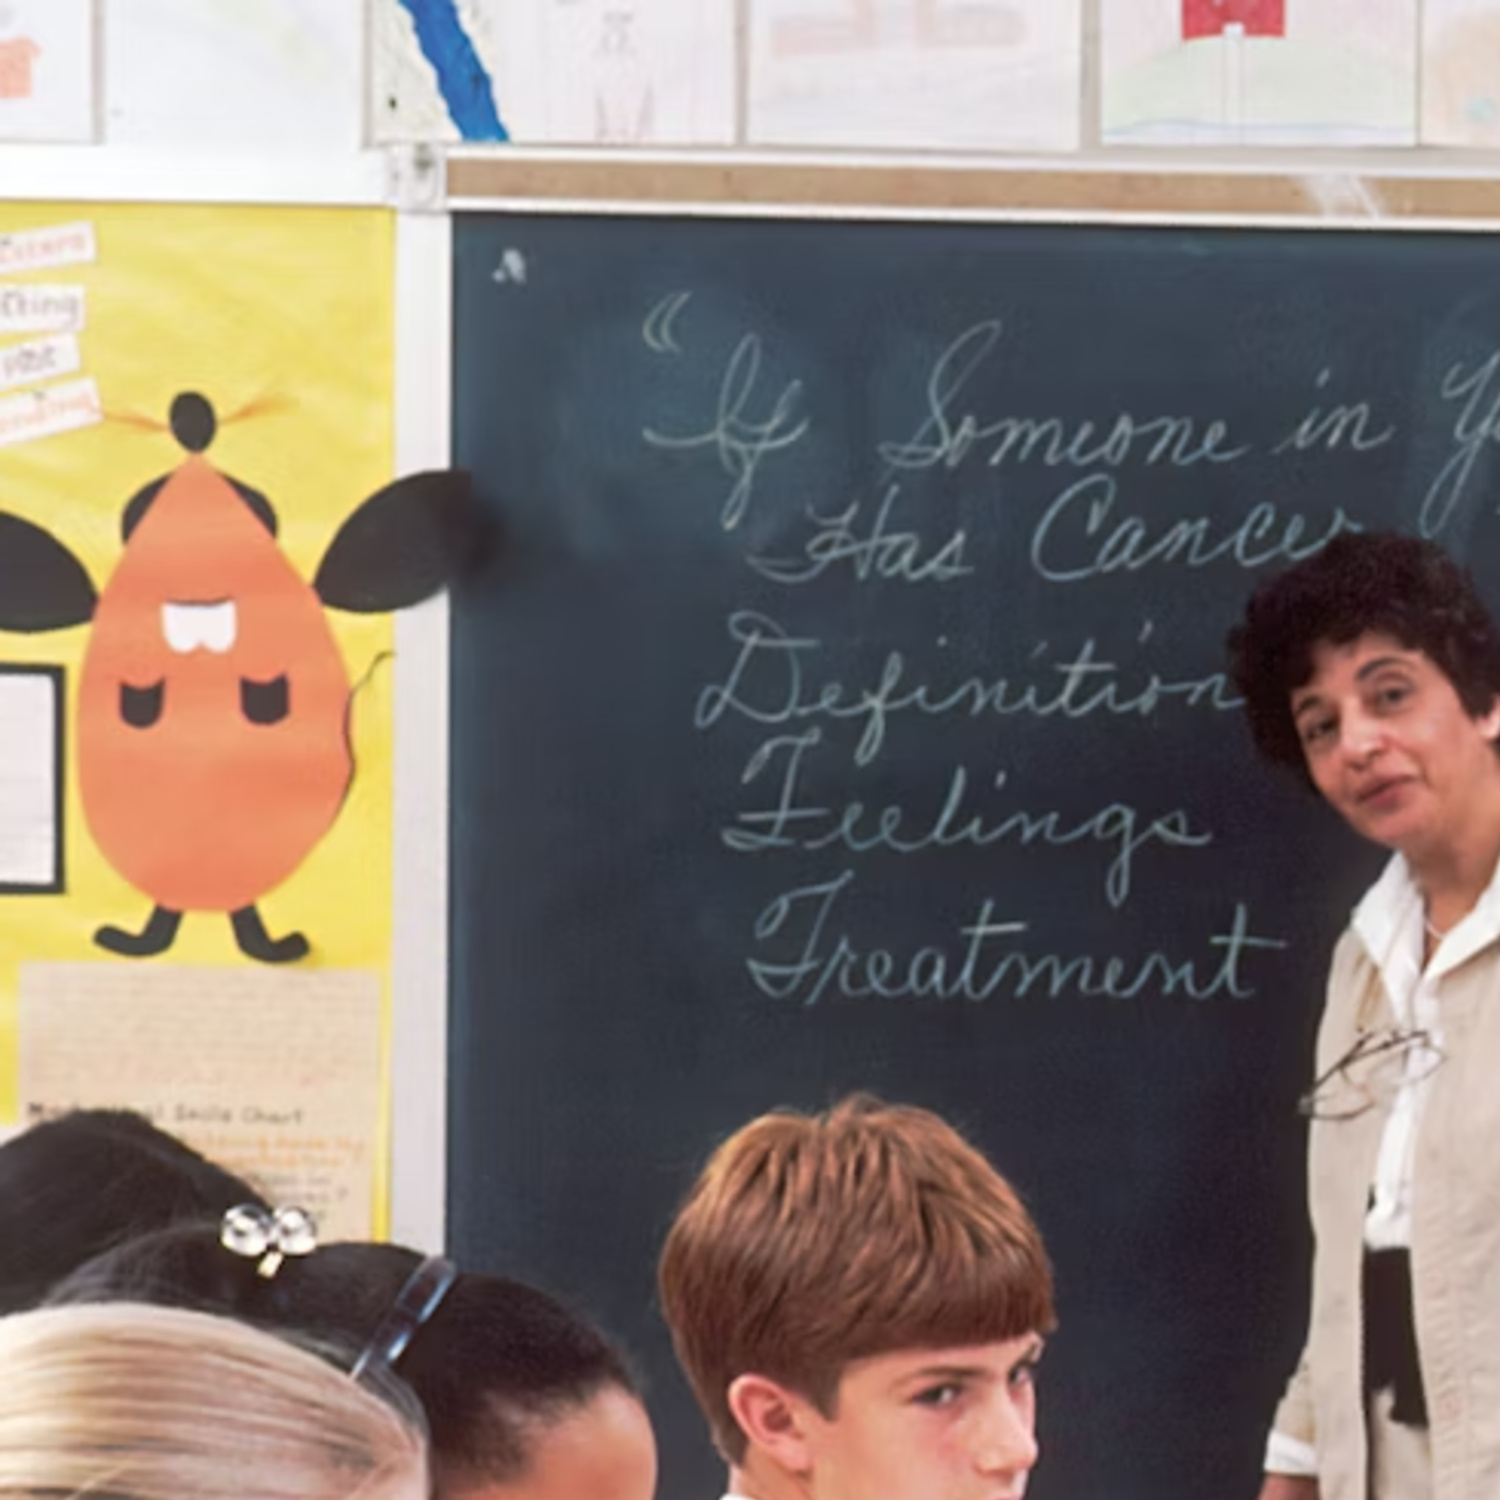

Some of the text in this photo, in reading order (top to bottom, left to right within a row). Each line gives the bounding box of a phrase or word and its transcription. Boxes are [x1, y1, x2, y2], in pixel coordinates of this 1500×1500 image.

[878, 320, 1248, 467] Someone
[1272, 367, 1395, 452] in
[745, 483, 973, 583] Has
[694, 610, 1246, 766] Definition
[721, 725, 1212, 908] Feelings
[746, 869, 1288, 1005] Treatment
